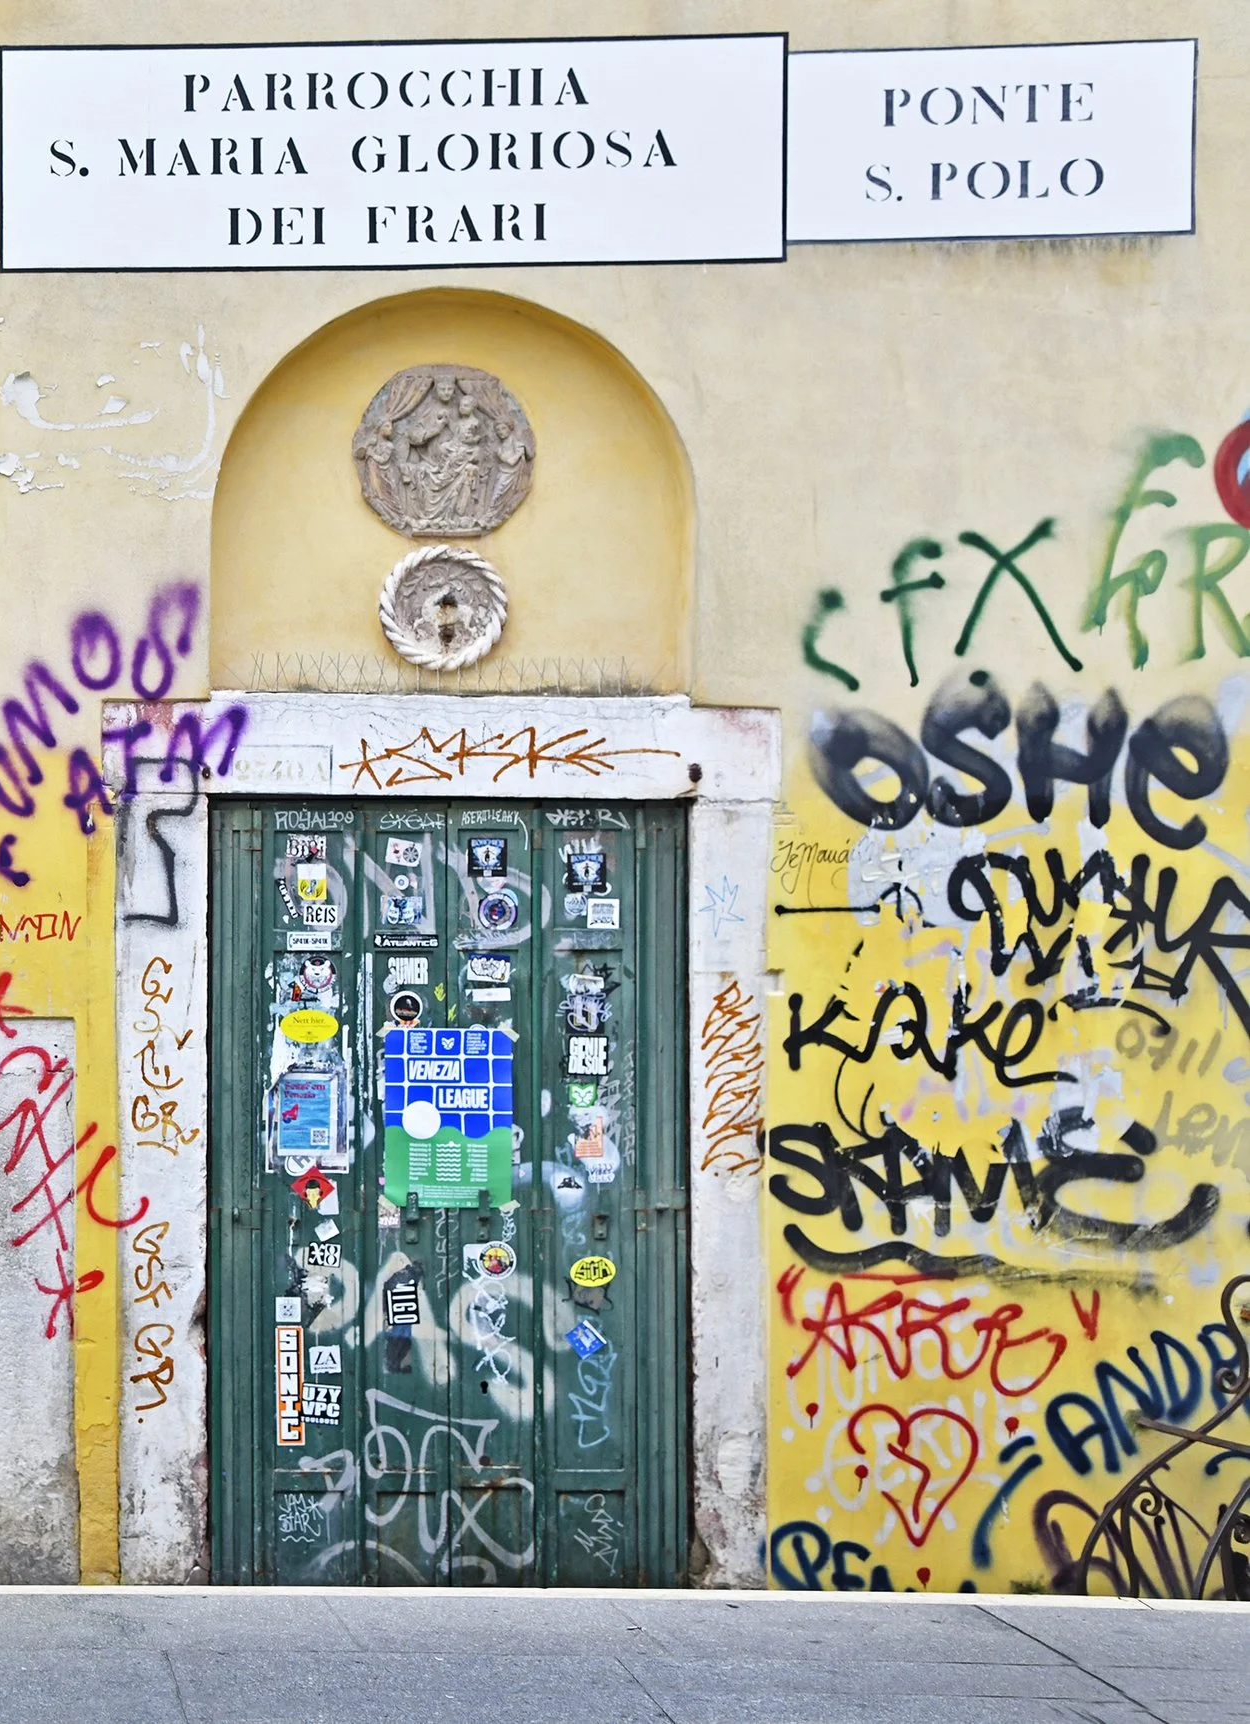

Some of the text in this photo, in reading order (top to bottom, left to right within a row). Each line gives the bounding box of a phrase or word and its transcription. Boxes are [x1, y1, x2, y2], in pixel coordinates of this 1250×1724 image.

[184, 67, 590, 113] PARROCCHIA
[884, 82, 1095, 127] PONTE
[50, 129, 678, 177] S. MARIA GLORIOSA
[865, 158, 1105, 202] S. POLO
[228, 203, 548, 246] DEI FRARI
[408, 1059, 460, 1082] VENEZIA
[438, 1087, 489, 1109] LEAGUE
[279, 1328, 300, 1441] SONIC
[301, 1386, 342, 1402] UZY
[300, 1415, 340, 1426] TOULOUSE
[301, 1402, 341, 1418] VPC
